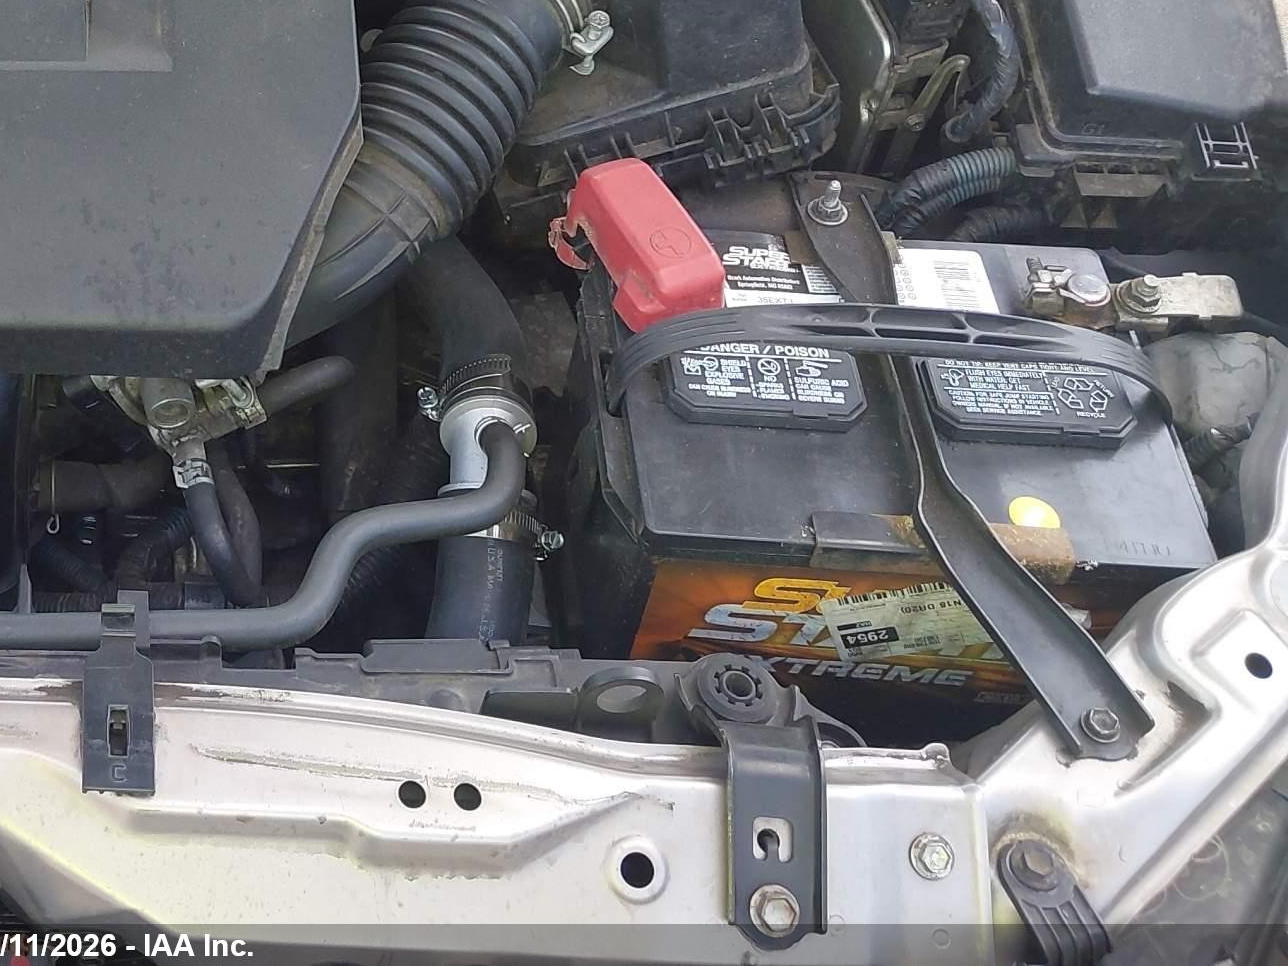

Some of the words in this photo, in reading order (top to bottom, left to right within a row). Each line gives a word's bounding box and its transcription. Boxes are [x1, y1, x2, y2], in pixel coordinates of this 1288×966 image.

[775, 345, 830, 358] POISON
[847, 630, 889, 645] 2954
[746, 655, 975, 687] XTREME
